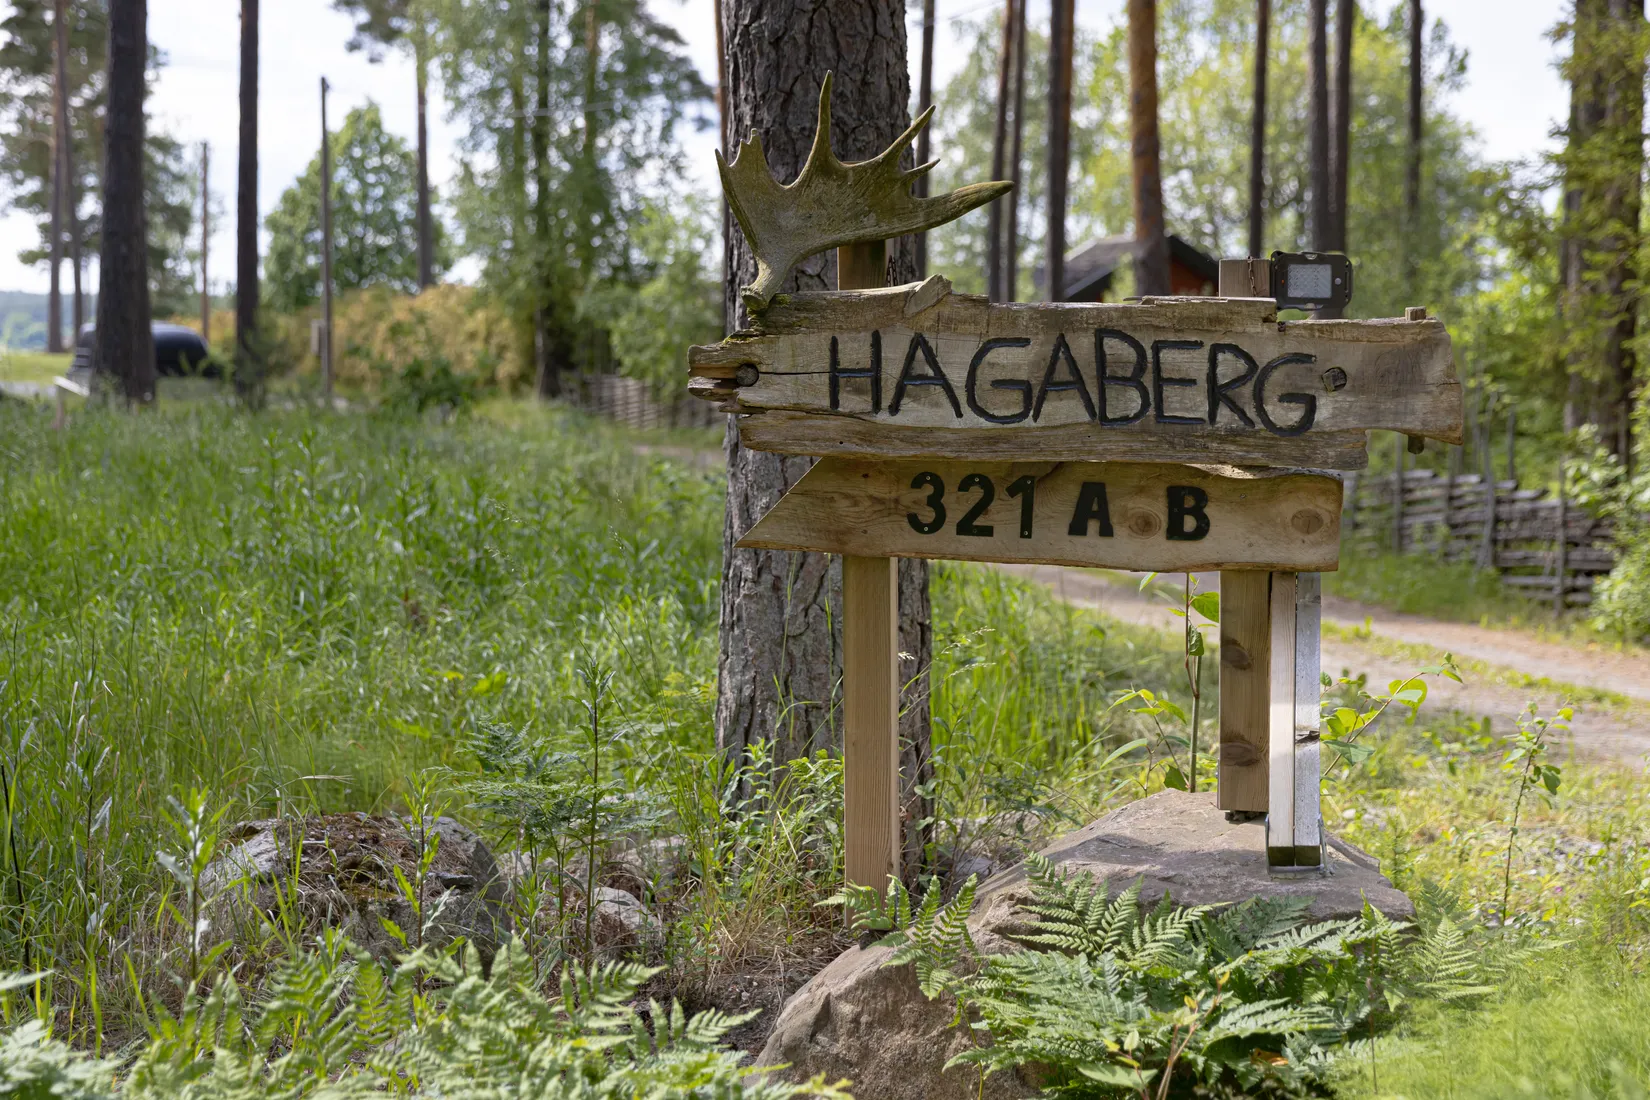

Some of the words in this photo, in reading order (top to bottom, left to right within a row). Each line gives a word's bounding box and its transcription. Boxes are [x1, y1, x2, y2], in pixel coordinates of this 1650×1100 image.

[829, 329, 1318, 437] HAGABERG
[906, 472, 1035, 539] 321
[1068, 482, 1114, 538] A
[1166, 485, 1210, 541] B
